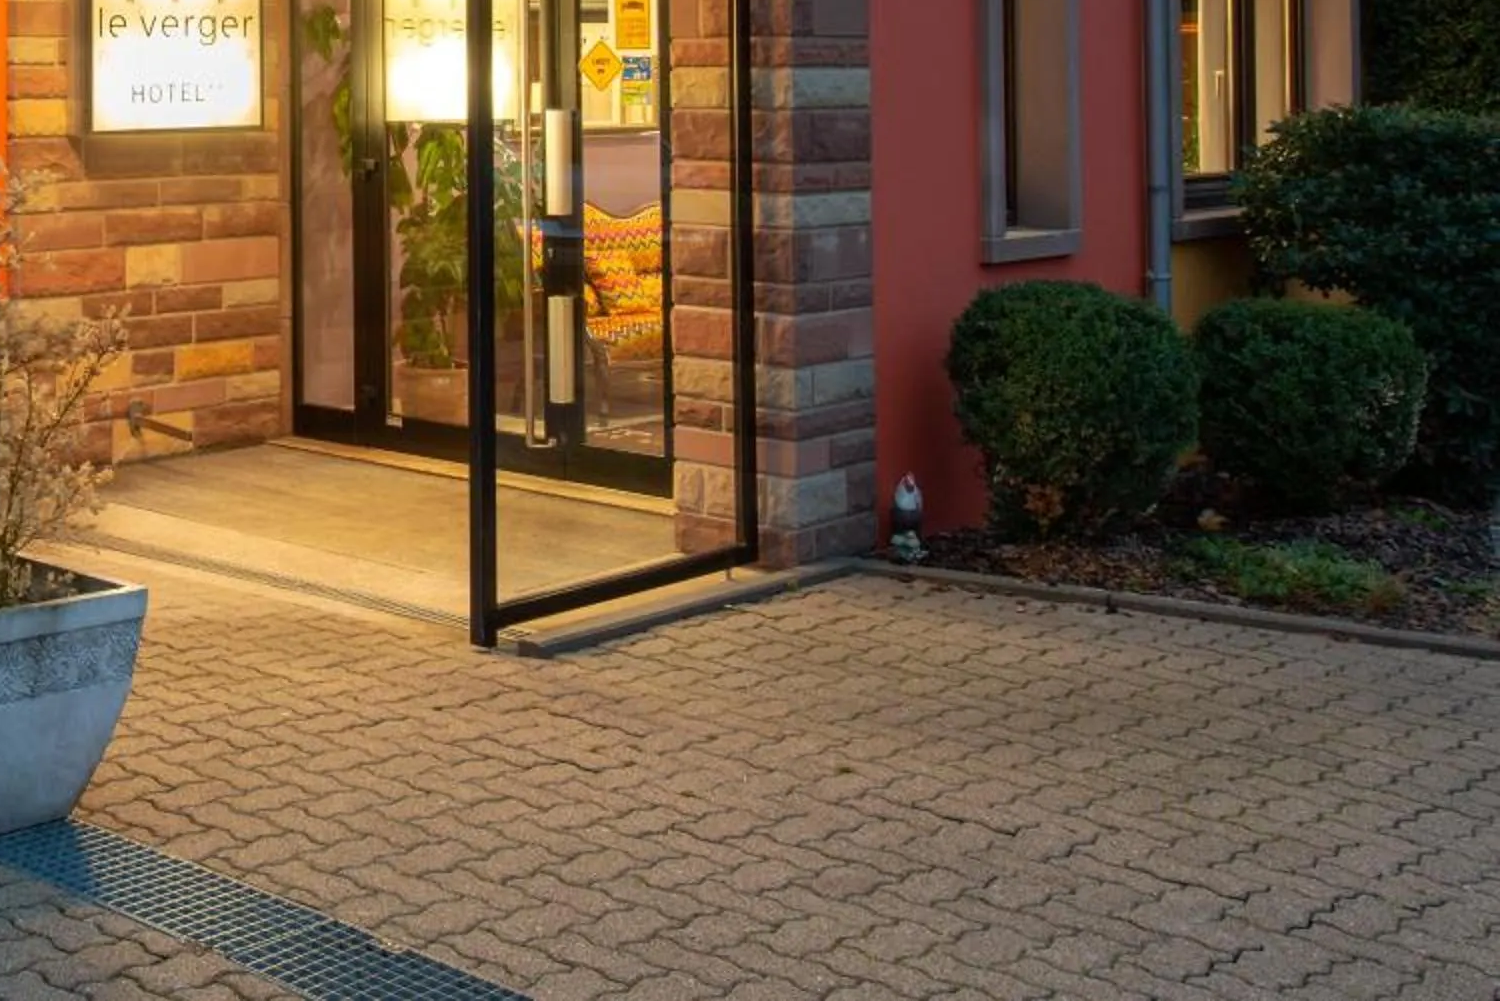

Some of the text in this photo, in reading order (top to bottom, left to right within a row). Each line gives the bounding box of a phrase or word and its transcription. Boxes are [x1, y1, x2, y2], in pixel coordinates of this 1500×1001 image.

[99, 7, 253, 46] le verger
[131, 82, 206, 104] HOTEL
